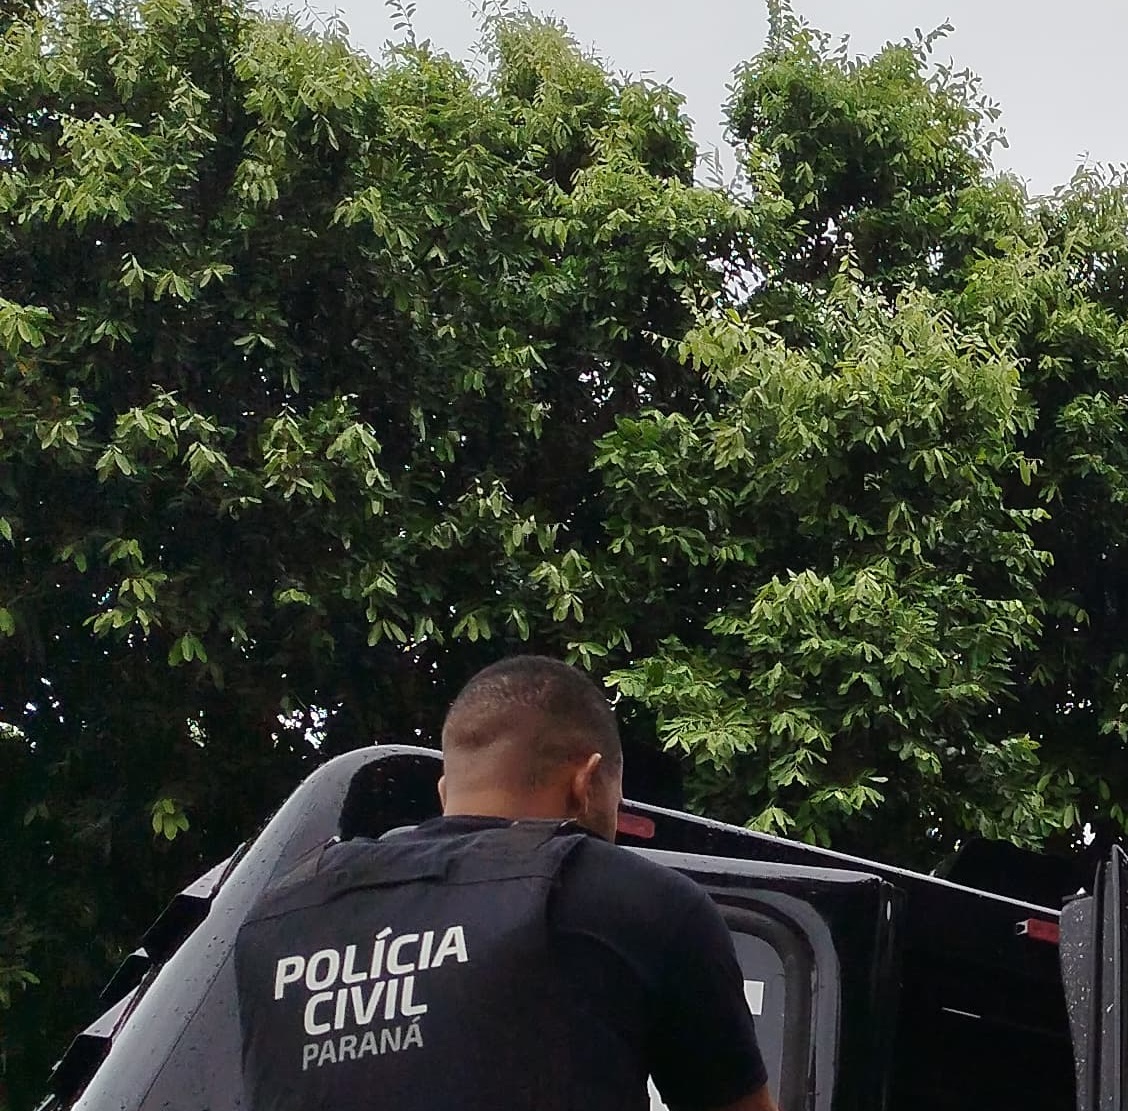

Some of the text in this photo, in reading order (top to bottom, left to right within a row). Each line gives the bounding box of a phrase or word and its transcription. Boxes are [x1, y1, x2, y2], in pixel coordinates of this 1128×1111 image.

[274, 925, 469, 1000] POLÍCIA
[303, 975, 428, 1036] CIVIL
[301, 1018, 424, 1071] PARANÁ
